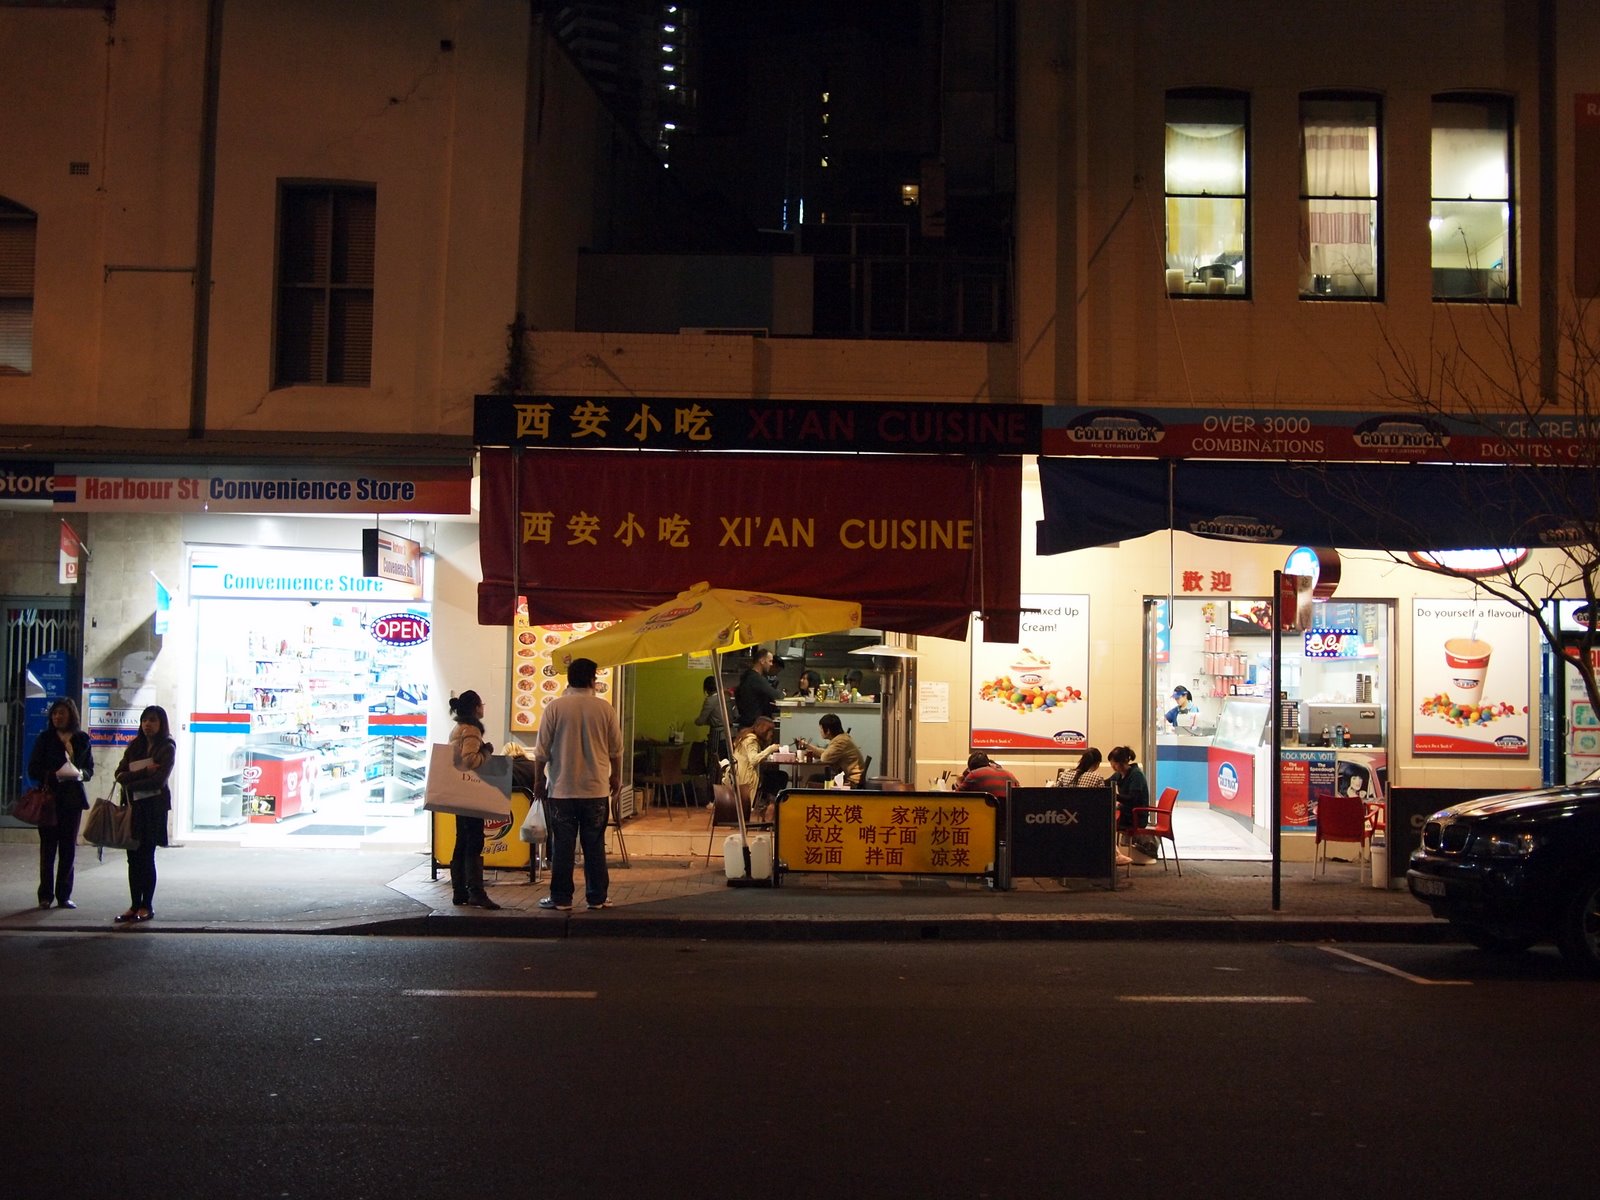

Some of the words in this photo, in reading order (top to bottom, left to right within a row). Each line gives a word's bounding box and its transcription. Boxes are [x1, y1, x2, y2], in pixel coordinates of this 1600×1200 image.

[513, 401, 714, 442] 西安小吃
[878, 411, 1026, 443] CUISINE
[1203, 415, 1256, 433] OVER
[1263, 416, 1311, 434] 3000
[1118, 428, 1157, 441] ROCK
[1191, 437, 1325, 453] COMBINATIONS
[85, 478, 173, 500] Harbour
[177, 477, 199, 499] St
[209, 477, 351, 501] Convenience
[356, 478, 415, 501] Store
[520, 511, 691, 547] 西安小吃
[839, 518, 974, 549] CUISINE
[223, 573, 335, 591] Convenience
[338, 575, 384, 592] Store
[1064, 607, 1079, 617] Up
[1417, 608, 1432, 617] Do
[1435, 608, 1475, 619] yourself
[1478, 610, 1485, 618] a
[1487, 608, 1525, 618] flavour!
[375, 621, 424, 639] OPEN
[1022, 622, 1057, 632] Cream!
[806, 804, 863, 824] 肉夹馍
[892, 806, 969, 826] 家常小炒
[1025, 809, 1079, 826] coffeX
[805, 824, 843, 843] 凉皮
[859, 825, 918, 844] 哨子面
[931, 826, 970, 846] 炒面
[805, 847, 843, 865] 汤面
[865, 847, 904, 866] 拌面
[931, 848, 970, 867] 凉菜
